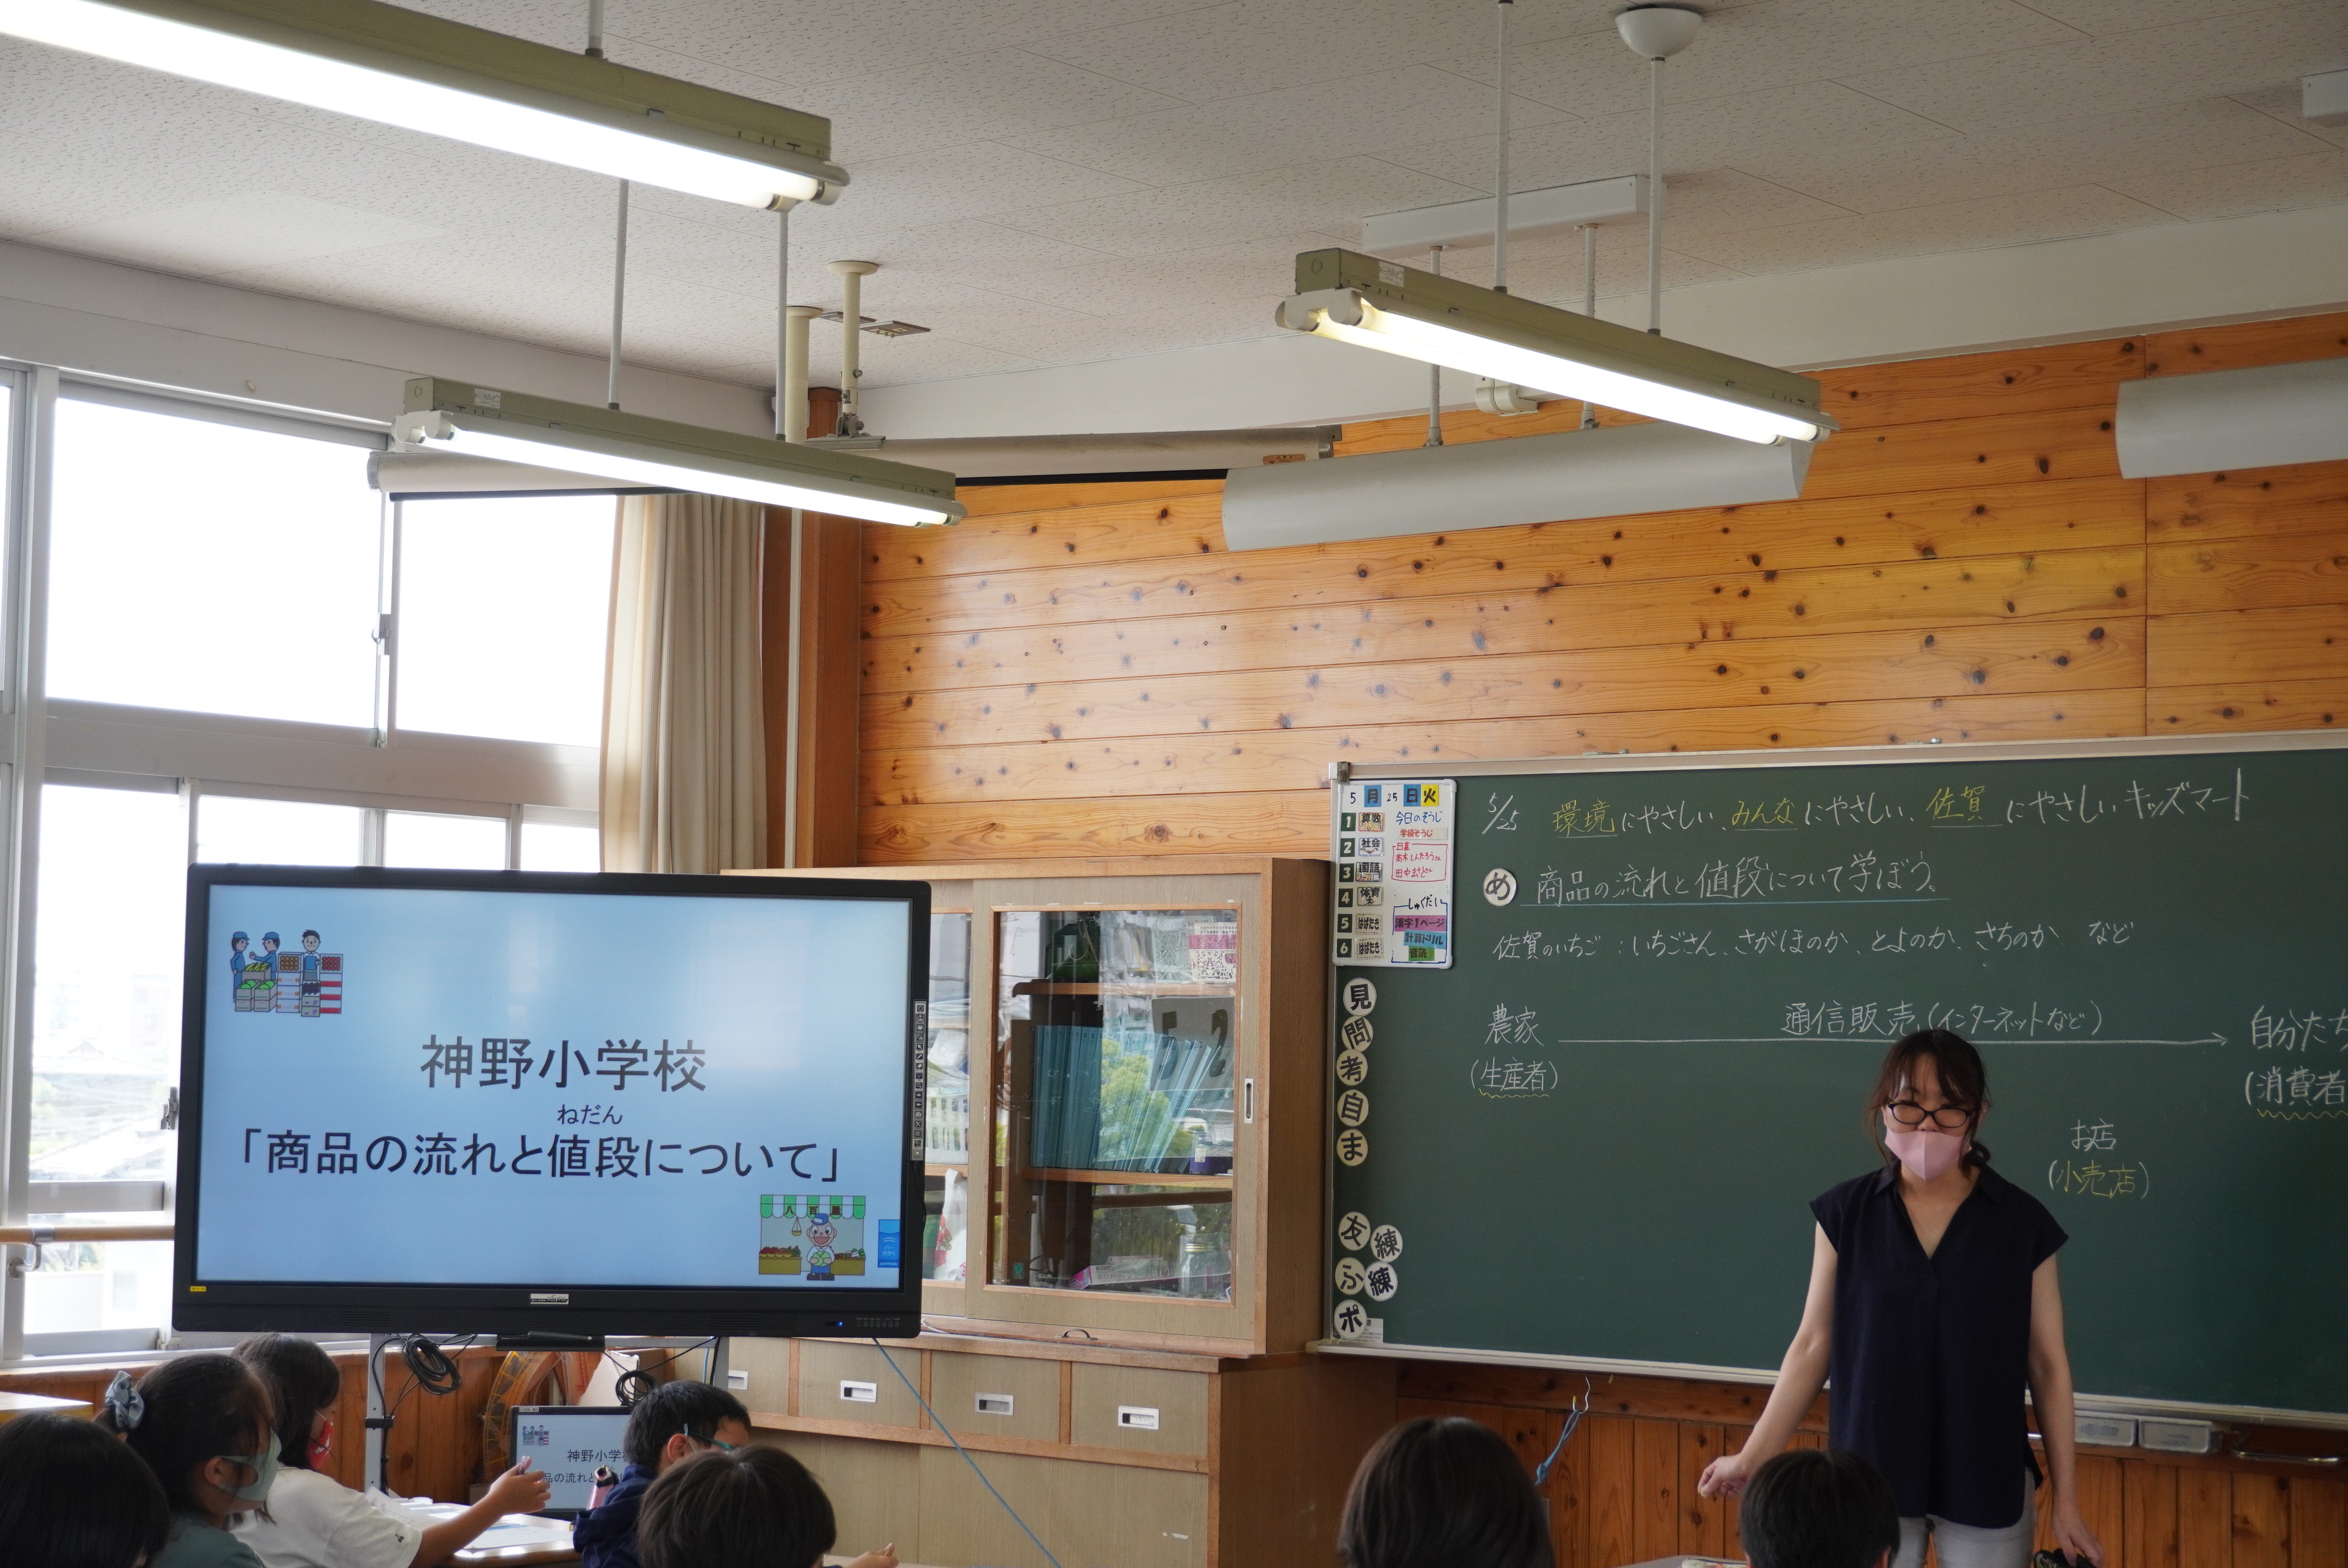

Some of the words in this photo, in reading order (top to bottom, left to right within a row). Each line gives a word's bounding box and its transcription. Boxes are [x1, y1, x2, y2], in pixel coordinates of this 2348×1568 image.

[1350, 792, 1356, 804] 5
[1367, 788, 1378, 803] 月
[1387, 793, 1397, 802] 25
[1407, 788, 1418, 803] 日
[1423, 788, 1436, 803] 火
[1346, 816, 1351, 828] 1
[1362, 813, 1381, 823] 算数
[1396, 811, 1443, 825] 今日のそうじ
[1400, 829, 1433, 837] 学級そうじ
[1343, 842, 1352, 853] 2
[1362, 839, 1380, 848] 社会
[1396, 841, 1410, 850] 日直
[1343, 867, 1351, 879] 3
[1360, 863, 1379, 873] 国語
[1341, 892, 1350, 904] 4
[1360, 888, 1380, 898] 体育
[1485, 873, 1510, 901] め
[1408, 894, 1443, 910] しゅくだい
[1341, 917, 1349, 929] 5
[1358, 917, 1379, 930] はばたき
[2089, 921, 2134, 944] など
[1340, 942, 1348, 954] 6
[1359, 942, 1380, 955] はばたき
[1405, 932, 1442, 945] 計算ドリル
[1409, 947, 1427, 958] 音読
[1350, 983, 1372, 1011] 見
[1344, 1017, 1372, 1049] 問
[1485, 1003, 1545, 1046] 農家
[420, 1034, 707, 1092] 神野小学校
[1340, 1055, 1363, 1082] 考
[557, 1103, 623, 1126] ねだん
[1341, 1092, 1363, 1122] 自
[243, 1128, 839, 1183] 「商品の流れと値段について」
[1341, 1133, 1363, 1161] ま
[1341, 1215, 1367, 1247] 友
[1374, 1228, 1400, 1259] 練
[1340, 1264, 1363, 1290] ふ
[1368, 1267, 1394, 1296] 練
[1339, 1304, 1363, 1332] ポ
[567, 1449, 626, 1462] 神野小学
